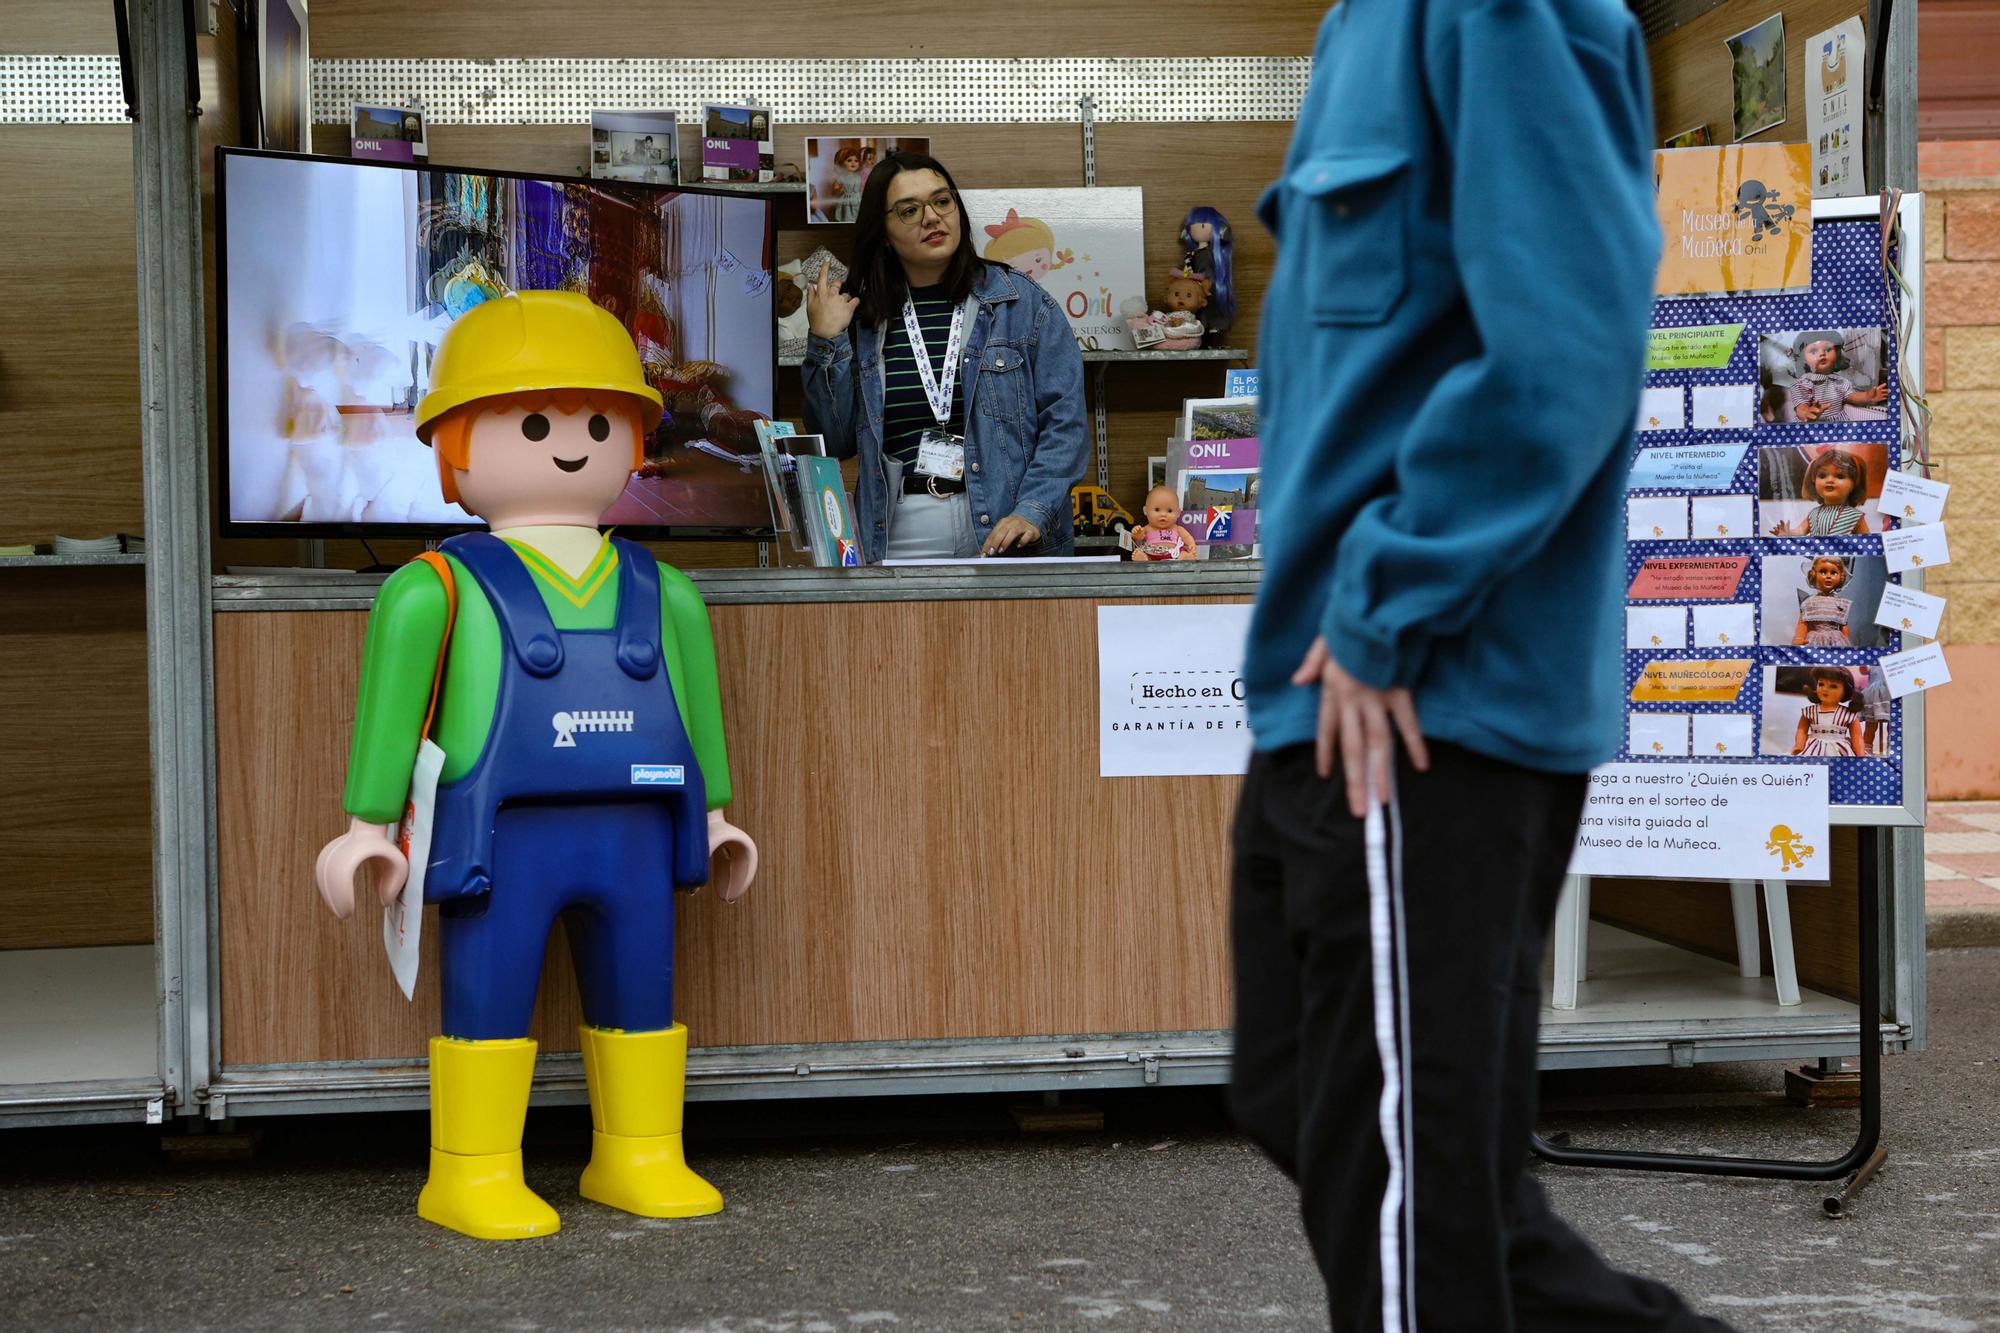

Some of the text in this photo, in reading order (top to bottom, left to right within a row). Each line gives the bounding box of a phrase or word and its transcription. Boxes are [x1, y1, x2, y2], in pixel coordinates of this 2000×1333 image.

[355, 140, 382, 151] ONIL
[706, 139, 731, 150] ONIL
[1681, 208, 1730, 233] Museo
[1681, 235, 1767, 259] Muñeca Onil
[1066, 287, 1113, 318] Onil
[1080, 324, 1121, 335] SUEÑOS
[1669, 330, 1725, 340] PRINCIPIANTE
[1233, 376, 1259, 385] EL PO
[1232, 385, 1259, 394] DE LA
[1189, 443, 1230, 458] ONIL
[1650, 450, 1726, 460] NIVEL INTERMEDIO
[1181, 513, 1207, 525] ONI
[1644, 561, 1738, 570] NIVEL EXPERMIENTADO
[1644, 670, 1743, 680] NIVEL MUÑECÓLOGA/O
[1142, 678, 1248, 701] Hecho en O
[1112, 719, 1252, 731] GARANTÍA DE FE
[634, 767, 681, 782] playmobil
[1585, 775, 1617, 787] uega
[1622, 775, 1631, 784] a
[1636, 774, 1684, 785] nuestro
[1742, 776, 1758, 786] es
[1762, 772, 1814, 787] Quién?'
[1590, 793, 1728, 807] entra en el sorteo de
[1580, 815, 1708, 830] una visita guiada al
[1580, 835, 1721, 850] Museo de la Muñeca.
